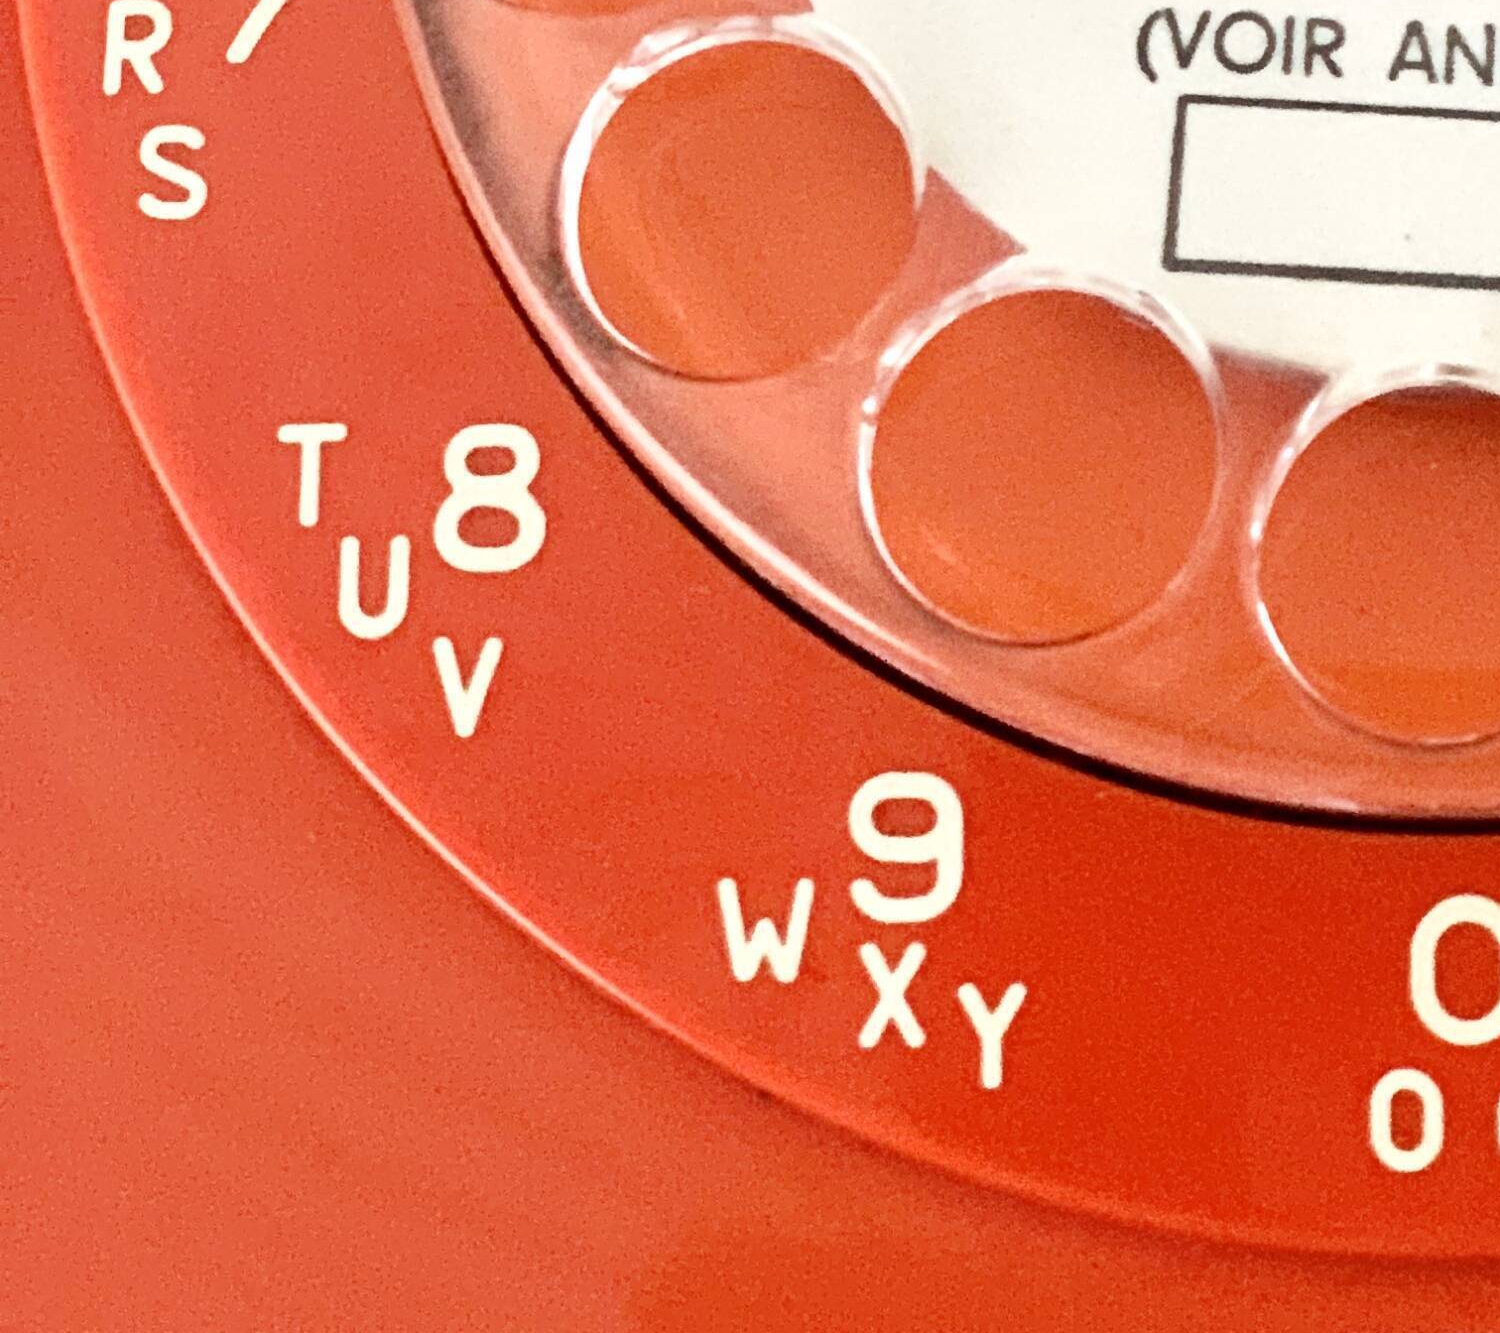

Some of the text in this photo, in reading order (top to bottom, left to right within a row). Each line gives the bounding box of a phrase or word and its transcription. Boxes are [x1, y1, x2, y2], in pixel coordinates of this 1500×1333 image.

[1136, 8, 1346, 83] (VOIR
[434, 424, 546, 572] 8
[848, 772, 963, 924] 9
